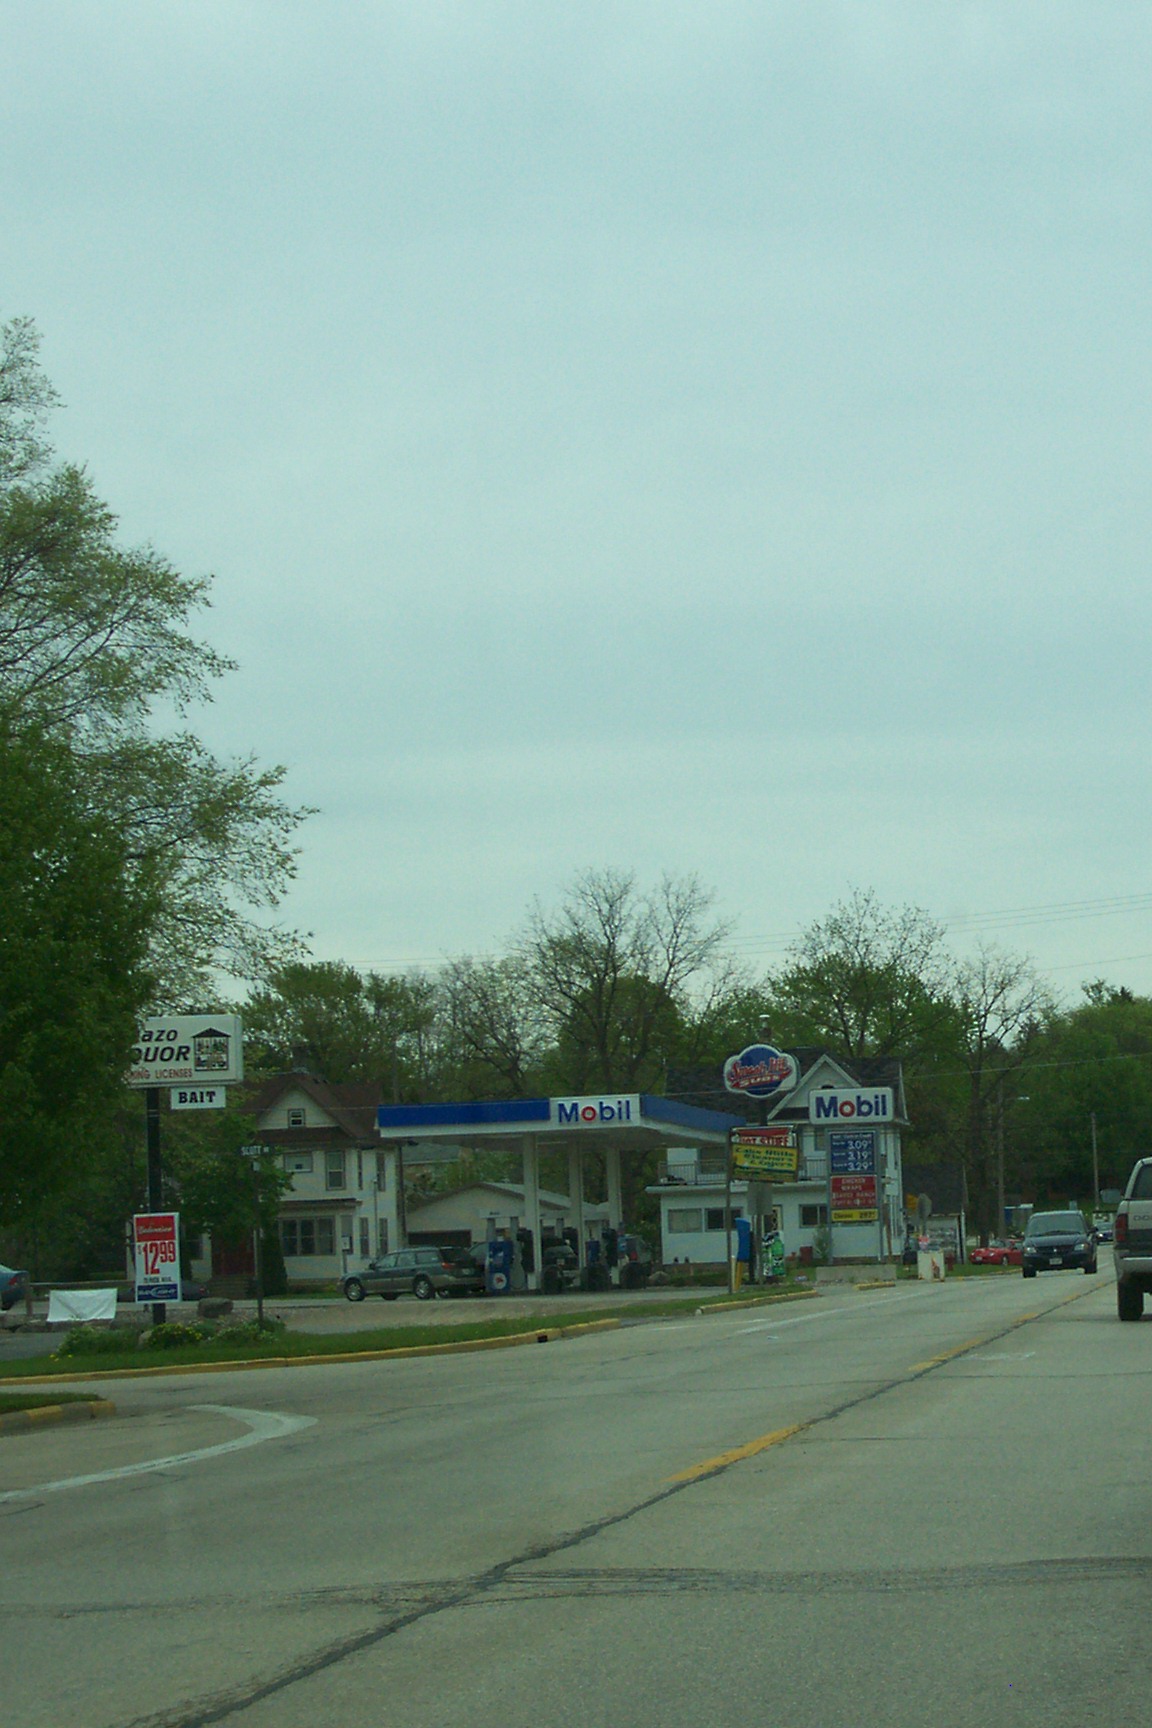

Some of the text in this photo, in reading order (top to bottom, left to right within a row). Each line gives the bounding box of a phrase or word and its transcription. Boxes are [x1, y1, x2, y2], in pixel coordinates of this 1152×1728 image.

[137, 1029, 178, 1043] azo
[154, 1068, 193, 1079] LICENSES
[178, 1091, 216, 1104] BAIT
[557, 1100, 631, 1123] Mobil
[815, 1094, 888, 1118] Mobil
